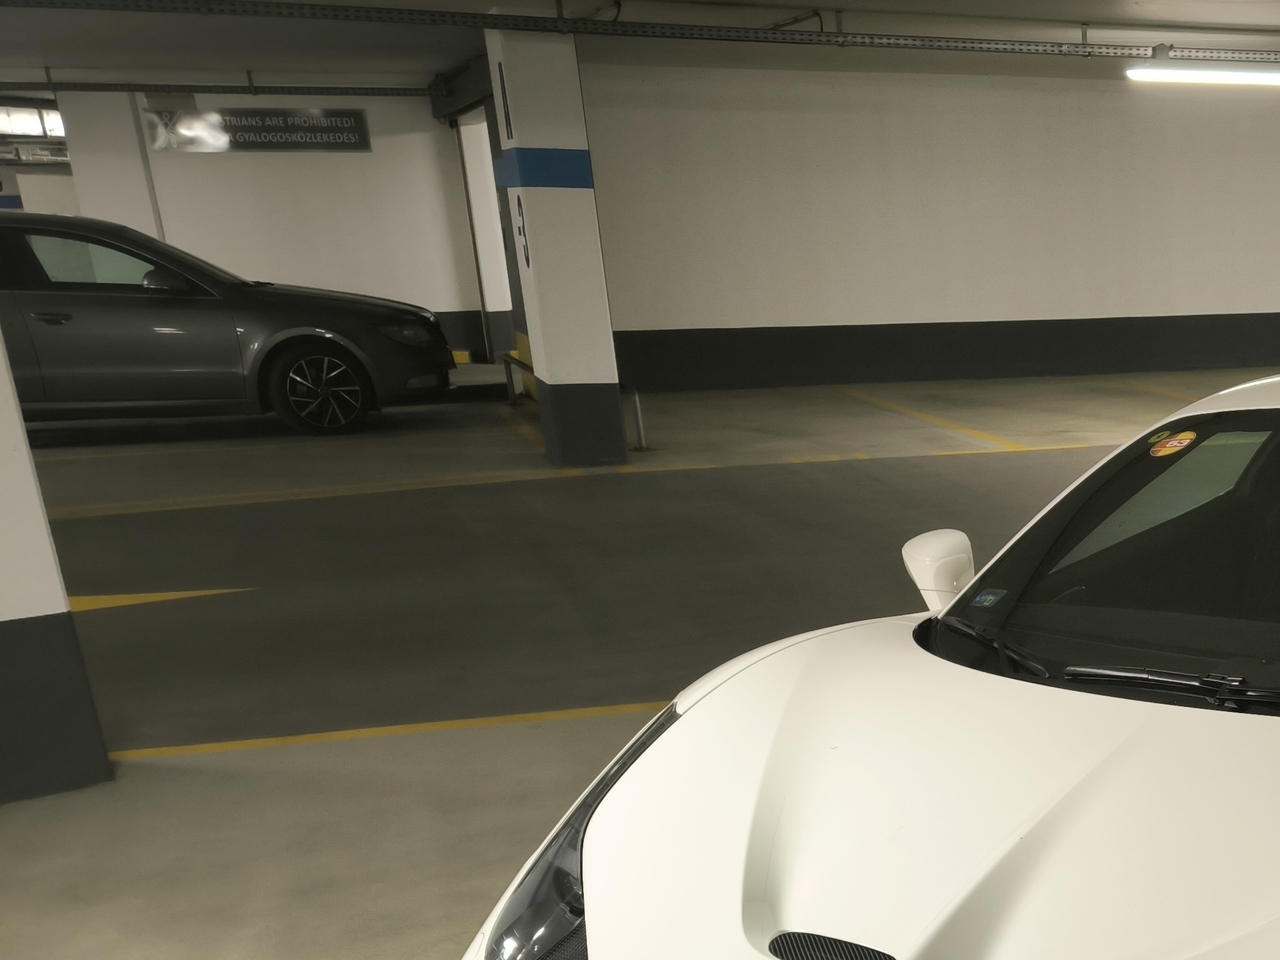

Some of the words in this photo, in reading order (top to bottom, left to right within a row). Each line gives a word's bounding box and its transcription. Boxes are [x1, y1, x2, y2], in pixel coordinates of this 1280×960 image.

[220, 116, 262, 127] STRIANS
[265, 117, 285, 127] ARE
[288, 116, 355, 127] PROHIBITED!
[236, 131, 359, 143] GYALOGOSKÖZLEKEDÉS!
